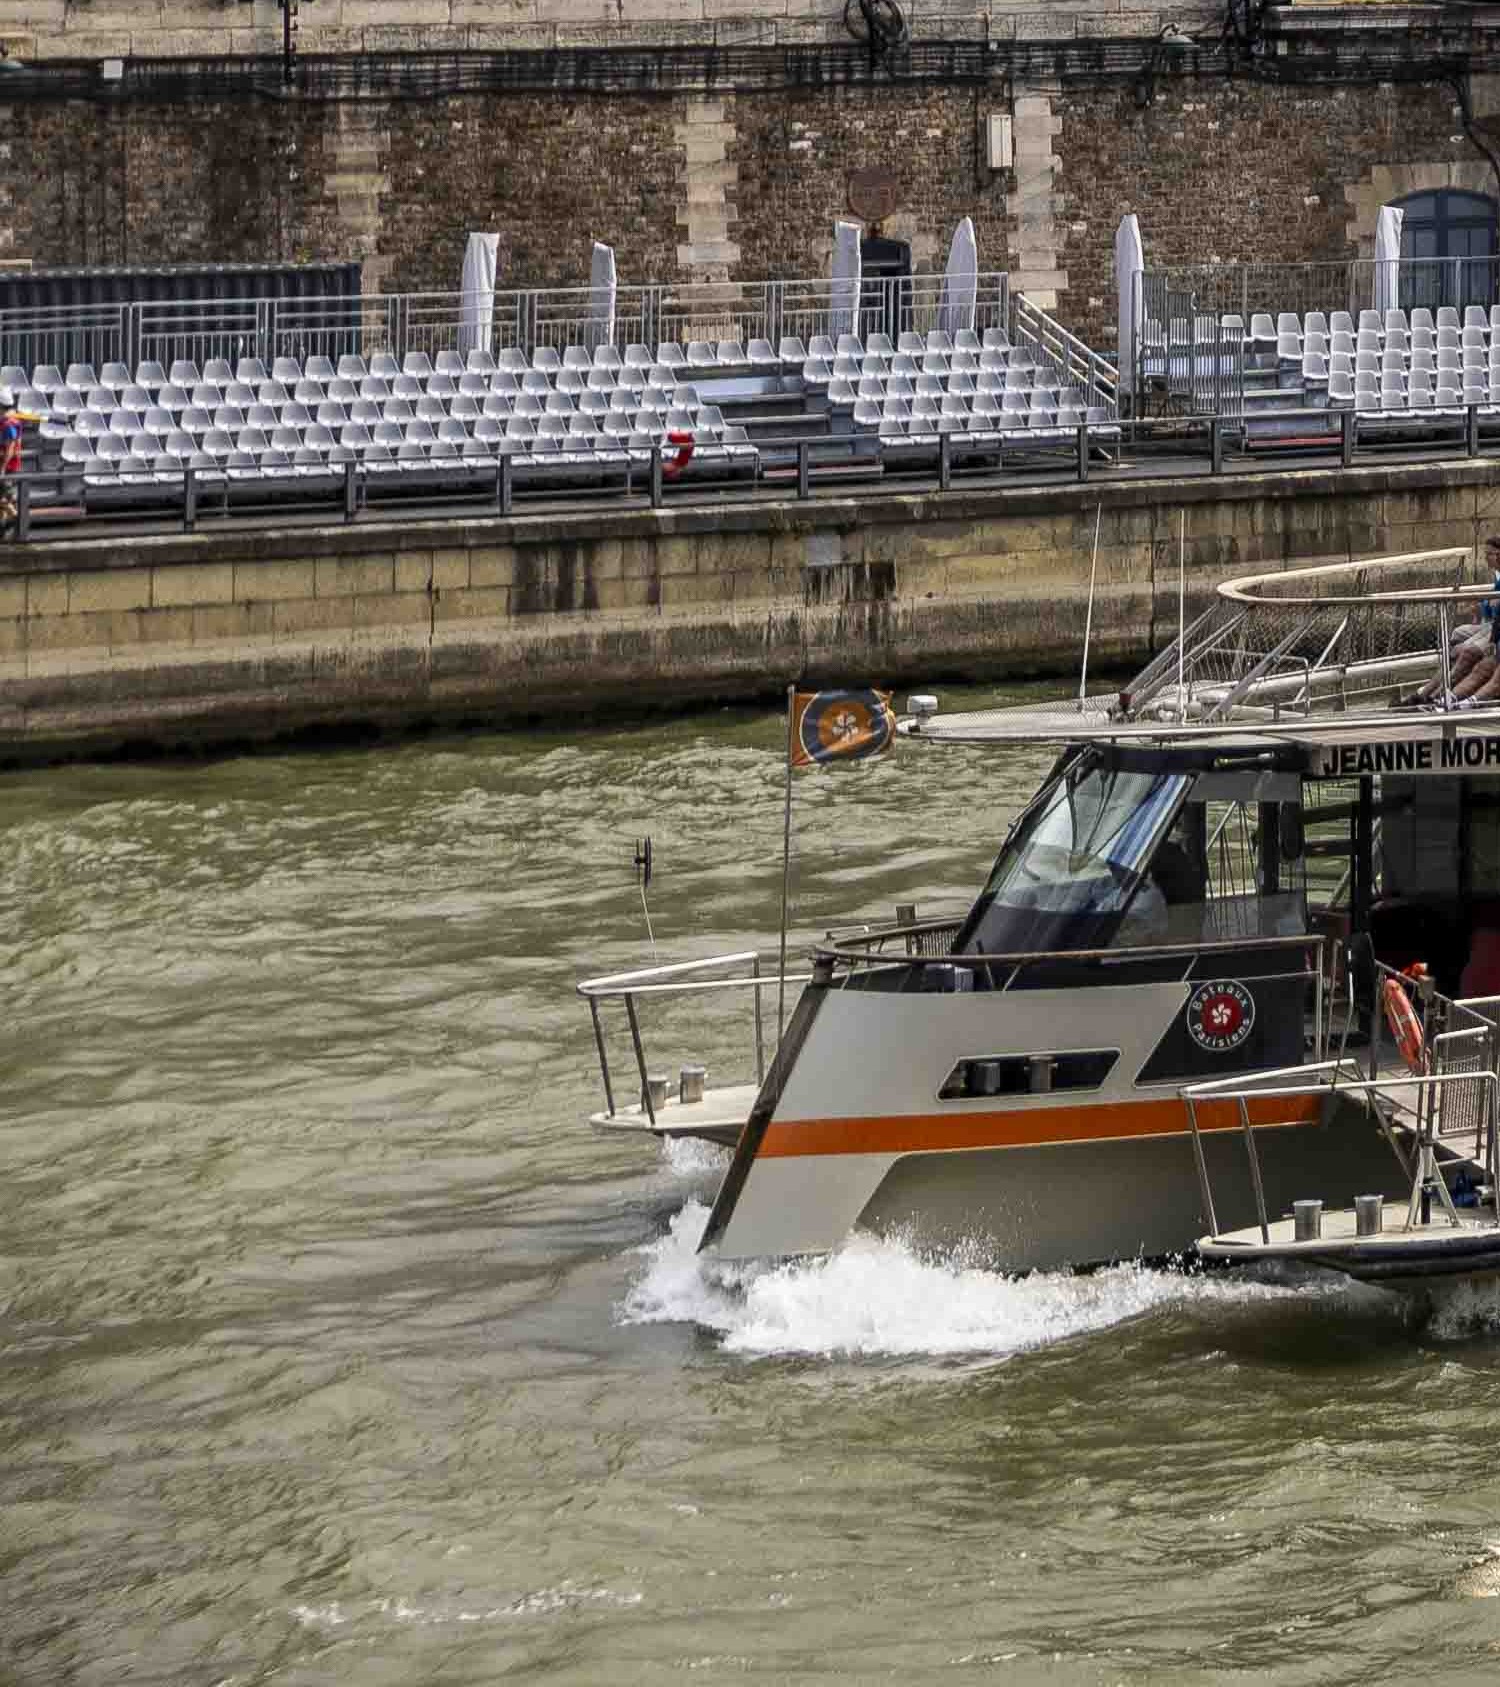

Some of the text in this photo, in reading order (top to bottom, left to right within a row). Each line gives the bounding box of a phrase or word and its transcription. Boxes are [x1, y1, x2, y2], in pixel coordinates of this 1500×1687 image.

[1322, 741, 1433, 776] JEANNE
[1192, 984, 1249, 1010] Bateaux
[1193, 1018, 1250, 1048] Parisiens
